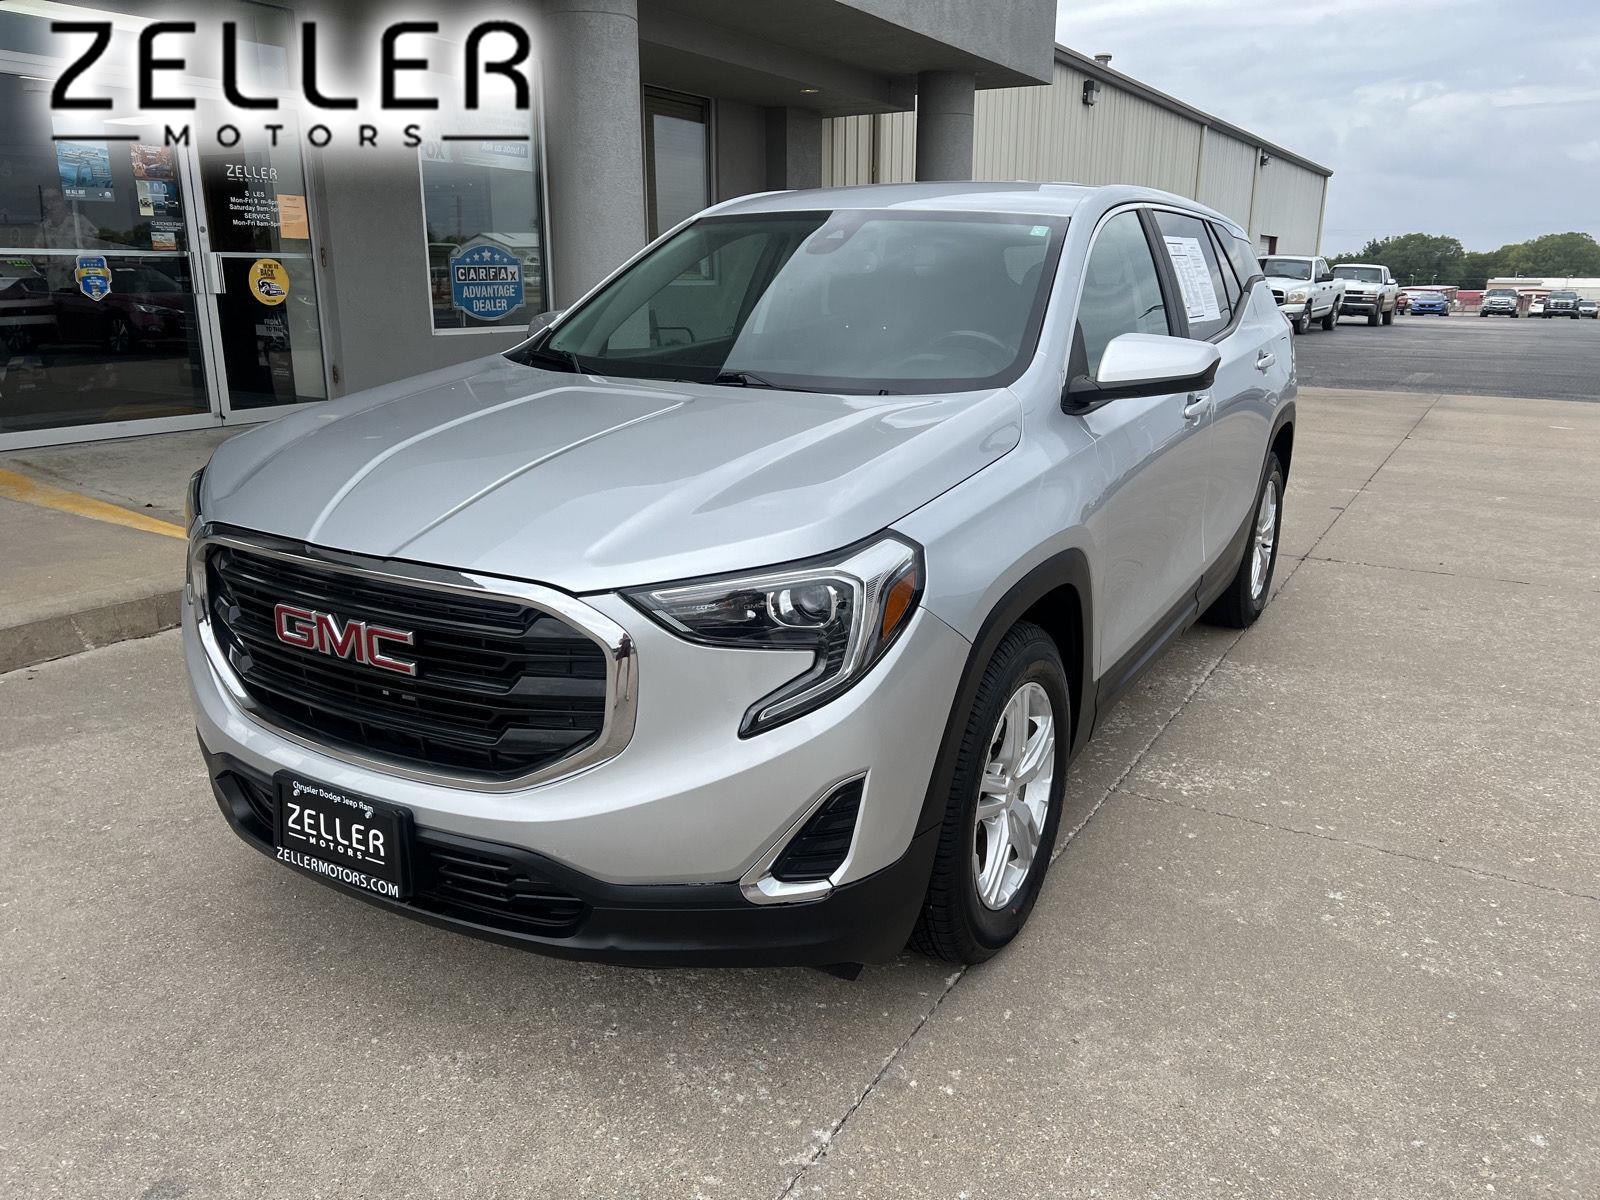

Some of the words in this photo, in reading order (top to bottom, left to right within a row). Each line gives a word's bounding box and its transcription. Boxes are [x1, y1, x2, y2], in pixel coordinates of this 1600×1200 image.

[225, 164, 278, 179] ZELLER
[230, 196, 253, 204] Mon-Fri
[229, 203, 256, 212] Saturday
[244, 212, 270, 220] SERVICE
[457, 267, 517, 281] CARFAX
[462, 284, 516, 298] ADVANTAGE
[473, 299, 508, 312] DEALER
[274, 603, 417, 677] GMC
[292, 780, 319, 795] Chrysler
[319, 788, 342, 804] Dodge
[342, 795, 359, 809] Jeep
[358, 801, 374, 813] Ram
[287, 802, 385, 857] ZELLER
[309, 835, 362, 860] MOTORS
[276, 846, 399, 898] ZELLERMOTORS.COM
